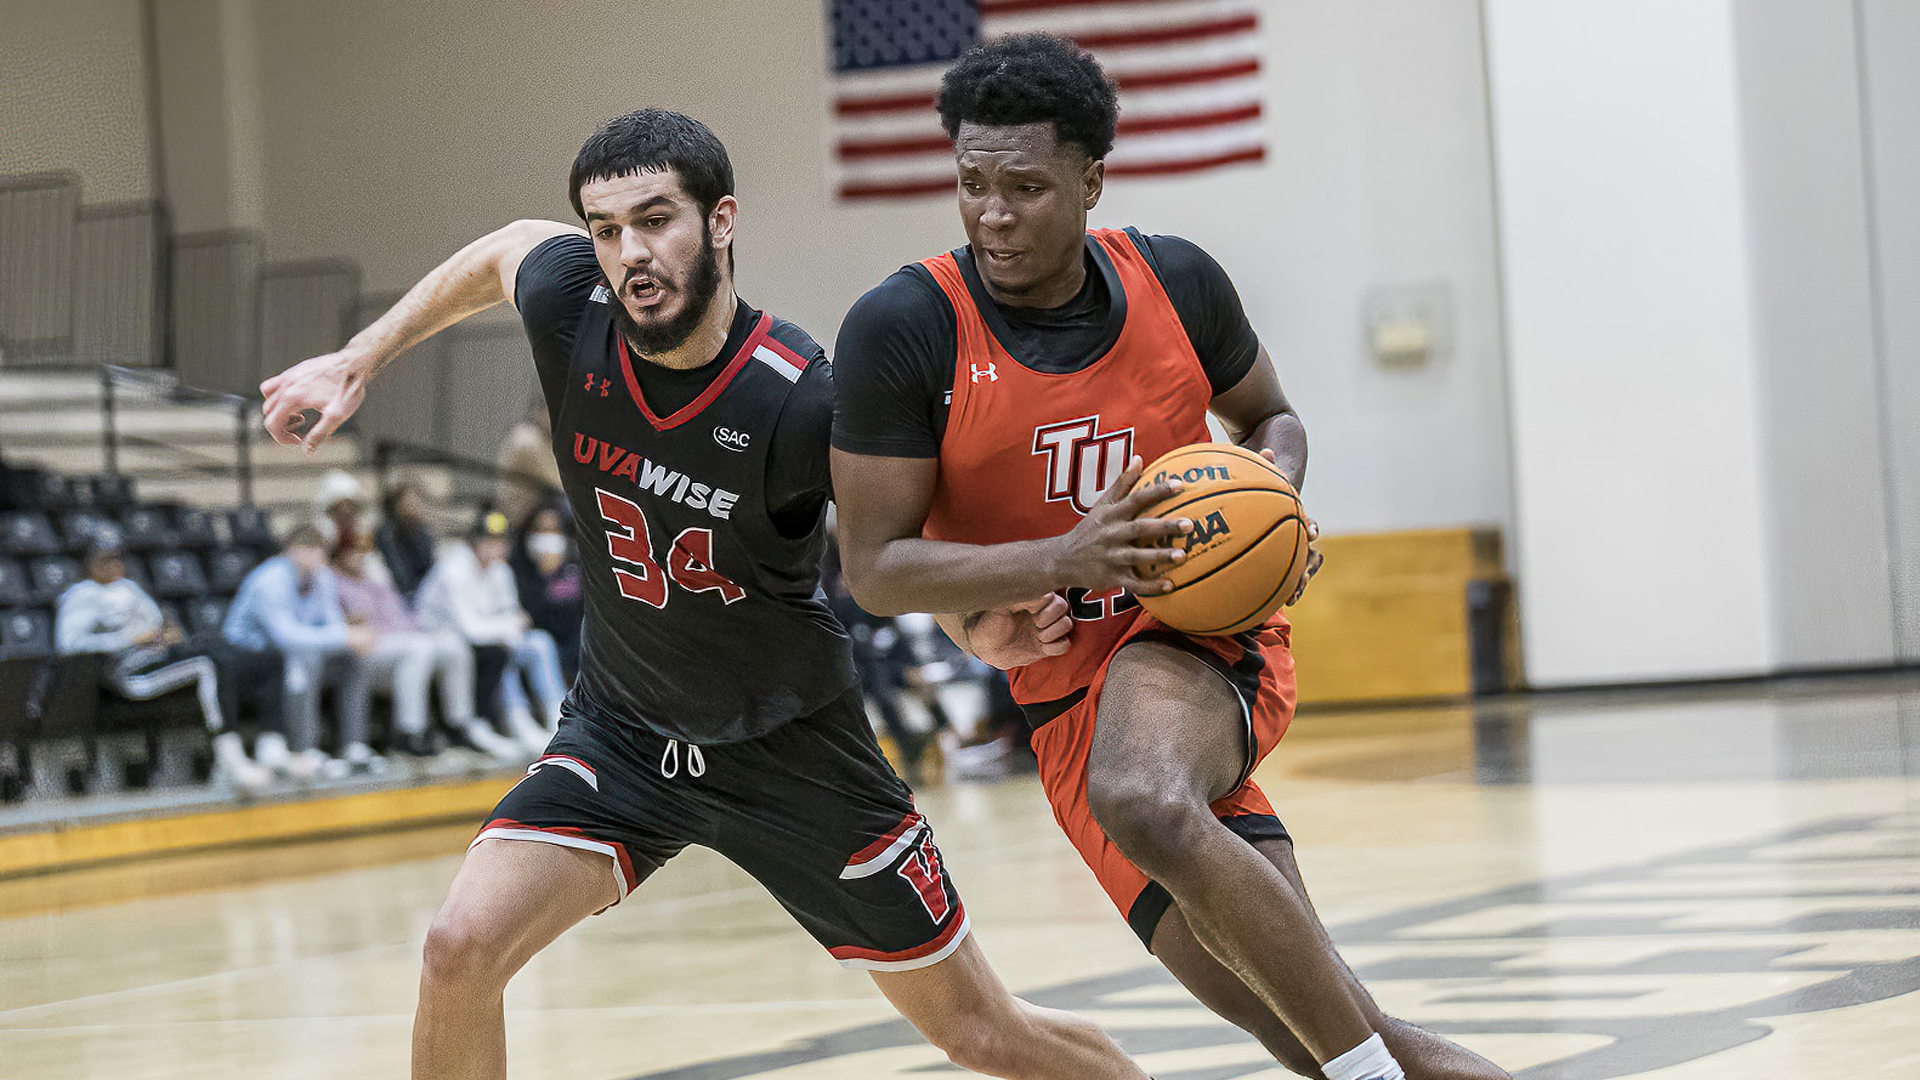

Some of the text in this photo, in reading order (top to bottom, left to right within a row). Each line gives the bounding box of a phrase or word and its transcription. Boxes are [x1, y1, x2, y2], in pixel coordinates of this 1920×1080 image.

[717, 427, 750, 448] SAC
[1032, 414, 1135, 517] TU
[594, 487, 747, 610] 34
